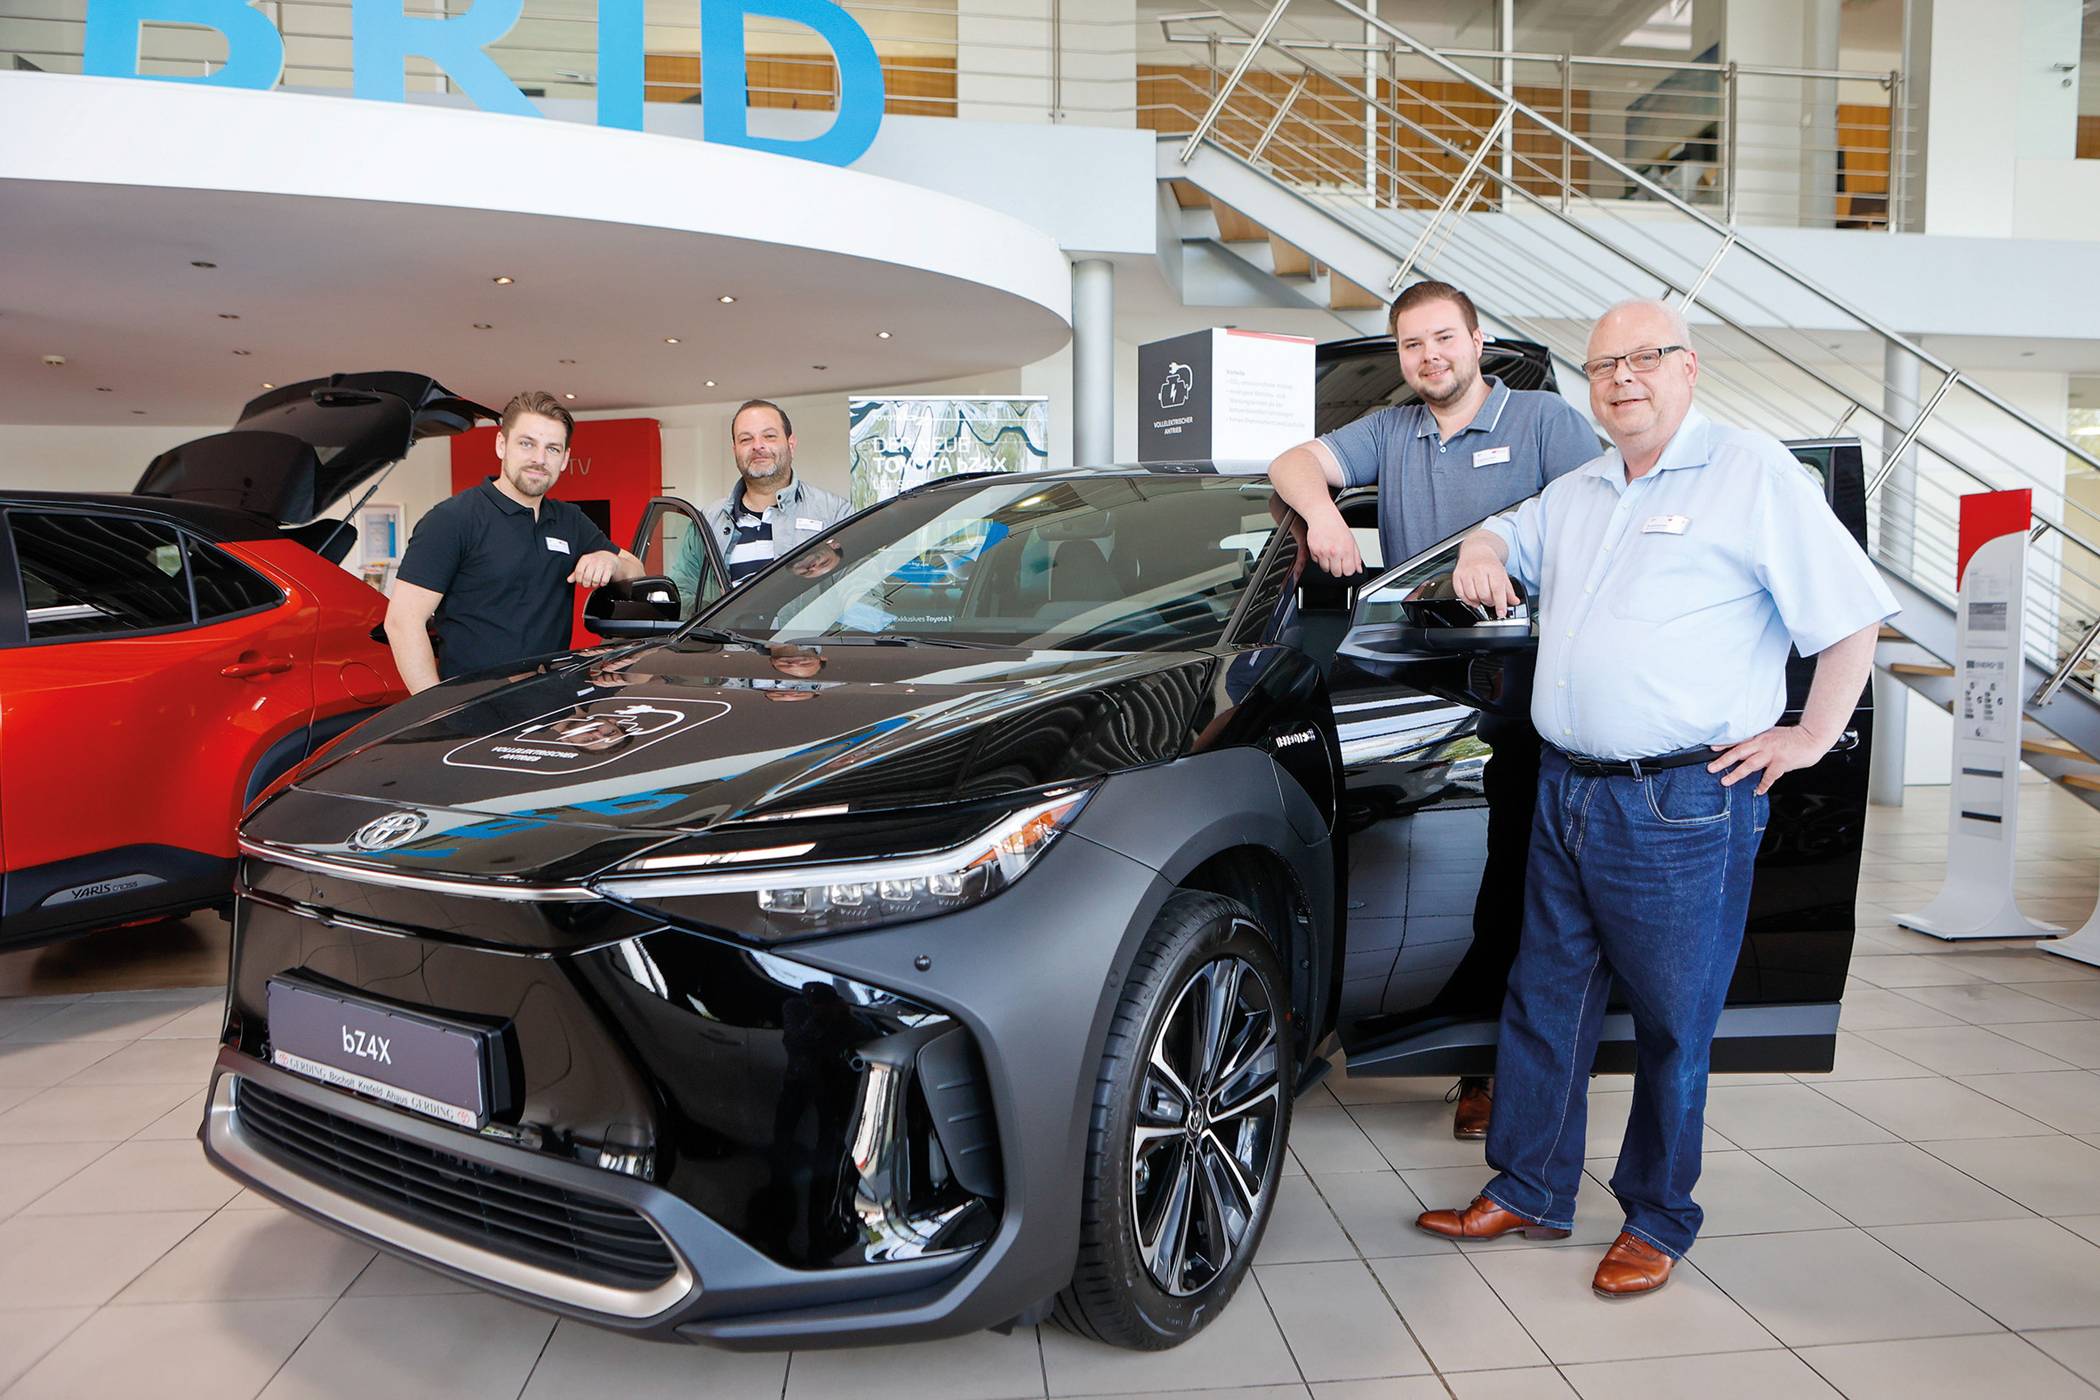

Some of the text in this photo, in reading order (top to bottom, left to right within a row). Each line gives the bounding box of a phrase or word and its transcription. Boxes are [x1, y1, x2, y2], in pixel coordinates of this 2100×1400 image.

[873, 437, 912, 453] DER
[873, 456, 1008, 474] TOYOTA bZ4X
[72, 884, 110, 899] YARIS
[342, 1024, 392, 1065] bZ4X
[289, 1058, 455, 1120] GERDING Bocholt Krefeld Ahaus GERDING
